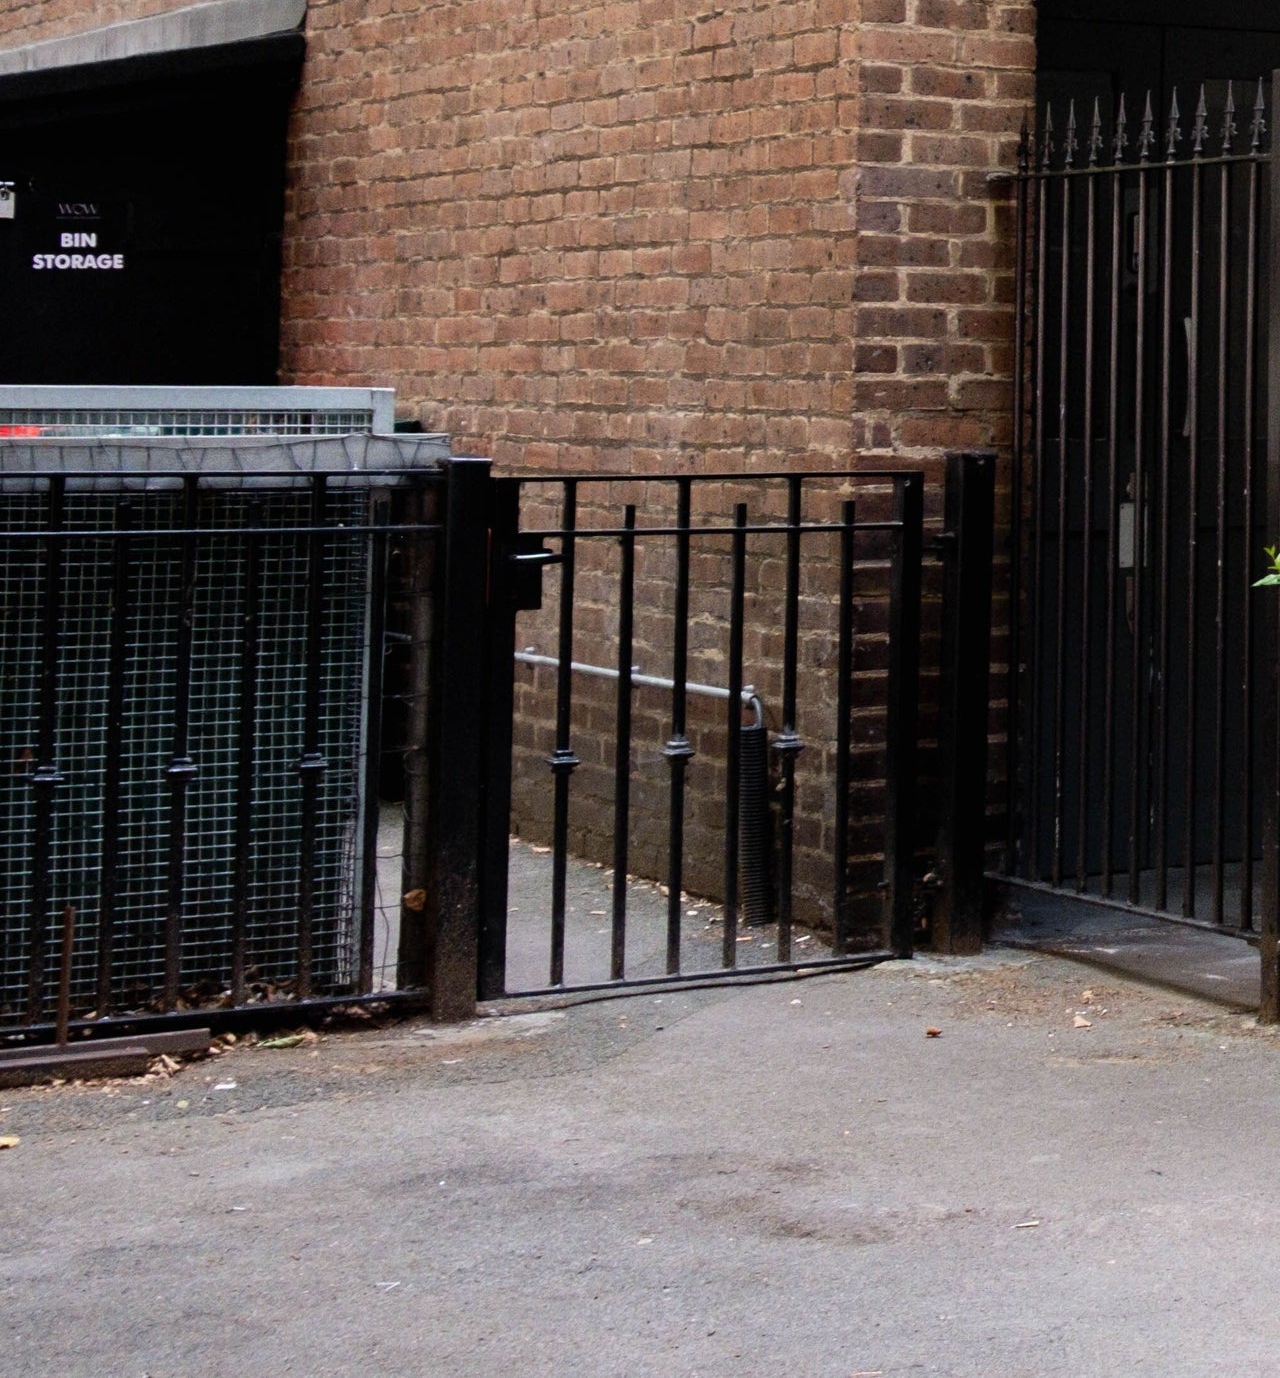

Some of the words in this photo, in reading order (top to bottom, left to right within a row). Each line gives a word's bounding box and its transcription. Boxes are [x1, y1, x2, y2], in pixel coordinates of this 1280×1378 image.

[58, 203, 100, 215] WOW
[61, 232, 97, 248] BIN
[32, 253, 124, 270] STORAGE
